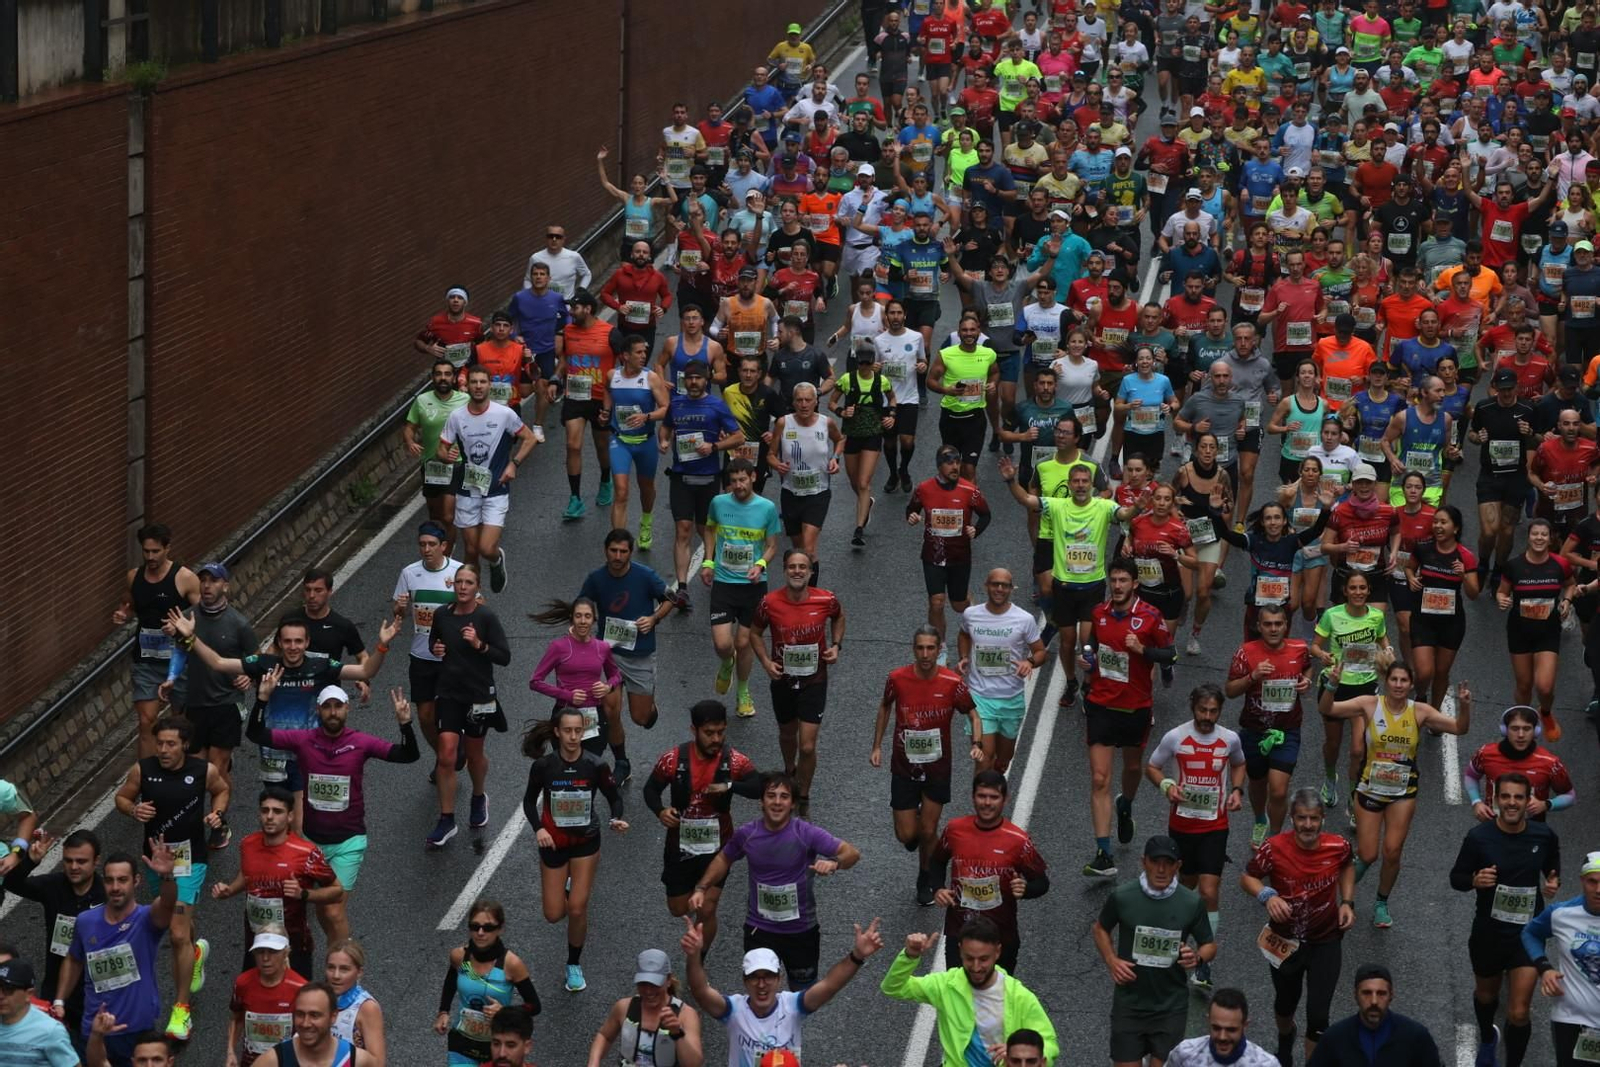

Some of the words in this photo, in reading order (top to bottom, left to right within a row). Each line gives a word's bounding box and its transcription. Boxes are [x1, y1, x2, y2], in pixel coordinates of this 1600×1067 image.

[1112, 181, 1136, 189] POPEYE
[936, 517, 957, 526] 5388
[723, 549, 748, 560] 10164
[1067, 550, 1093, 562] 15170
[973, 627, 1009, 638] Herbalife
[788, 652, 811, 664] 7344
[979, 651, 1003, 663] 7374
[1265, 686, 1293, 699] 10177
[909, 738, 933, 750] 6564
[1380, 734, 1411, 745] CORRE
[313, 782, 340, 797] 9332
[684, 827, 711, 842] 9374
[1502, 892, 1528, 909] 7893
[1140, 936, 1170, 951] 9812
[95, 956, 125, 976] 6789
